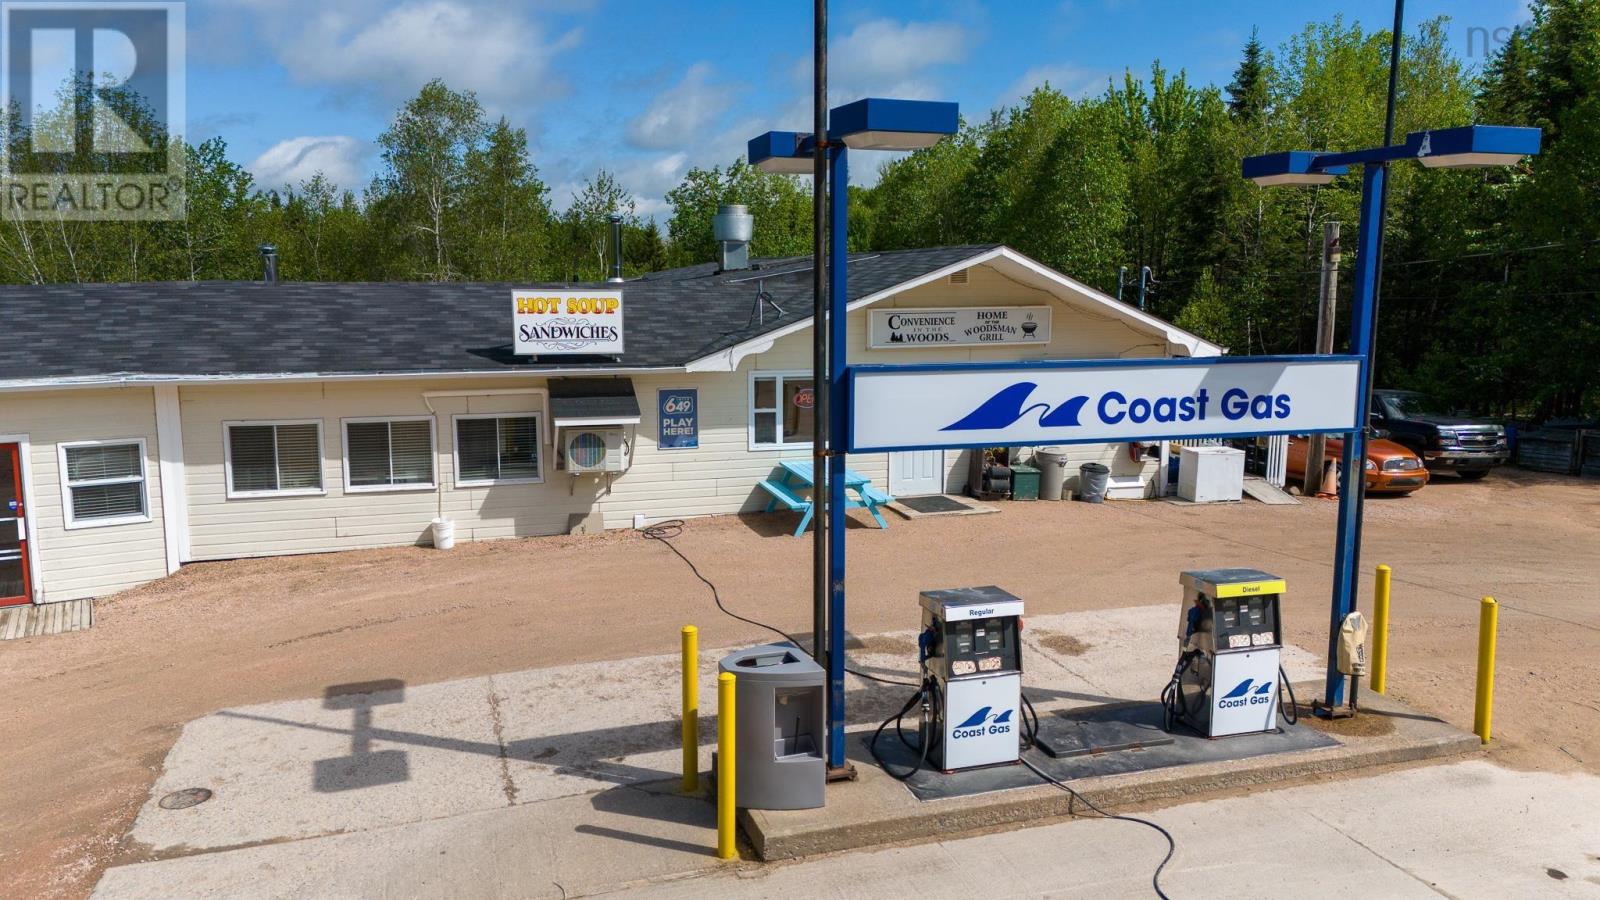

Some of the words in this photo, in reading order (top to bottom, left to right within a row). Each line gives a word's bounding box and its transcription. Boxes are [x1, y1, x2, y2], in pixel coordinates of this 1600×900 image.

[517, 297, 561, 314] HOT
[567, 297, 619, 314] SOUP
[977, 312, 1008, 320] HOME
[888, 315, 955, 330] CONVENIENCE
[519, 324, 618, 342] SANDWICHES
[964, 325, 1017, 336] WOODSMAN
[907, 333, 949, 342] WOODS
[1097, 388, 1209, 424] Coast
[1220, 388, 1291, 420] Gas
[664, 418, 693, 427] PLAY
[664, 428, 694, 436] HERE!
[1218, 697, 1247, 708] Coast
[1250, 696, 1269, 704] Gas
[952, 726, 985, 738] Coast
[988, 725, 1010, 734] Gas
